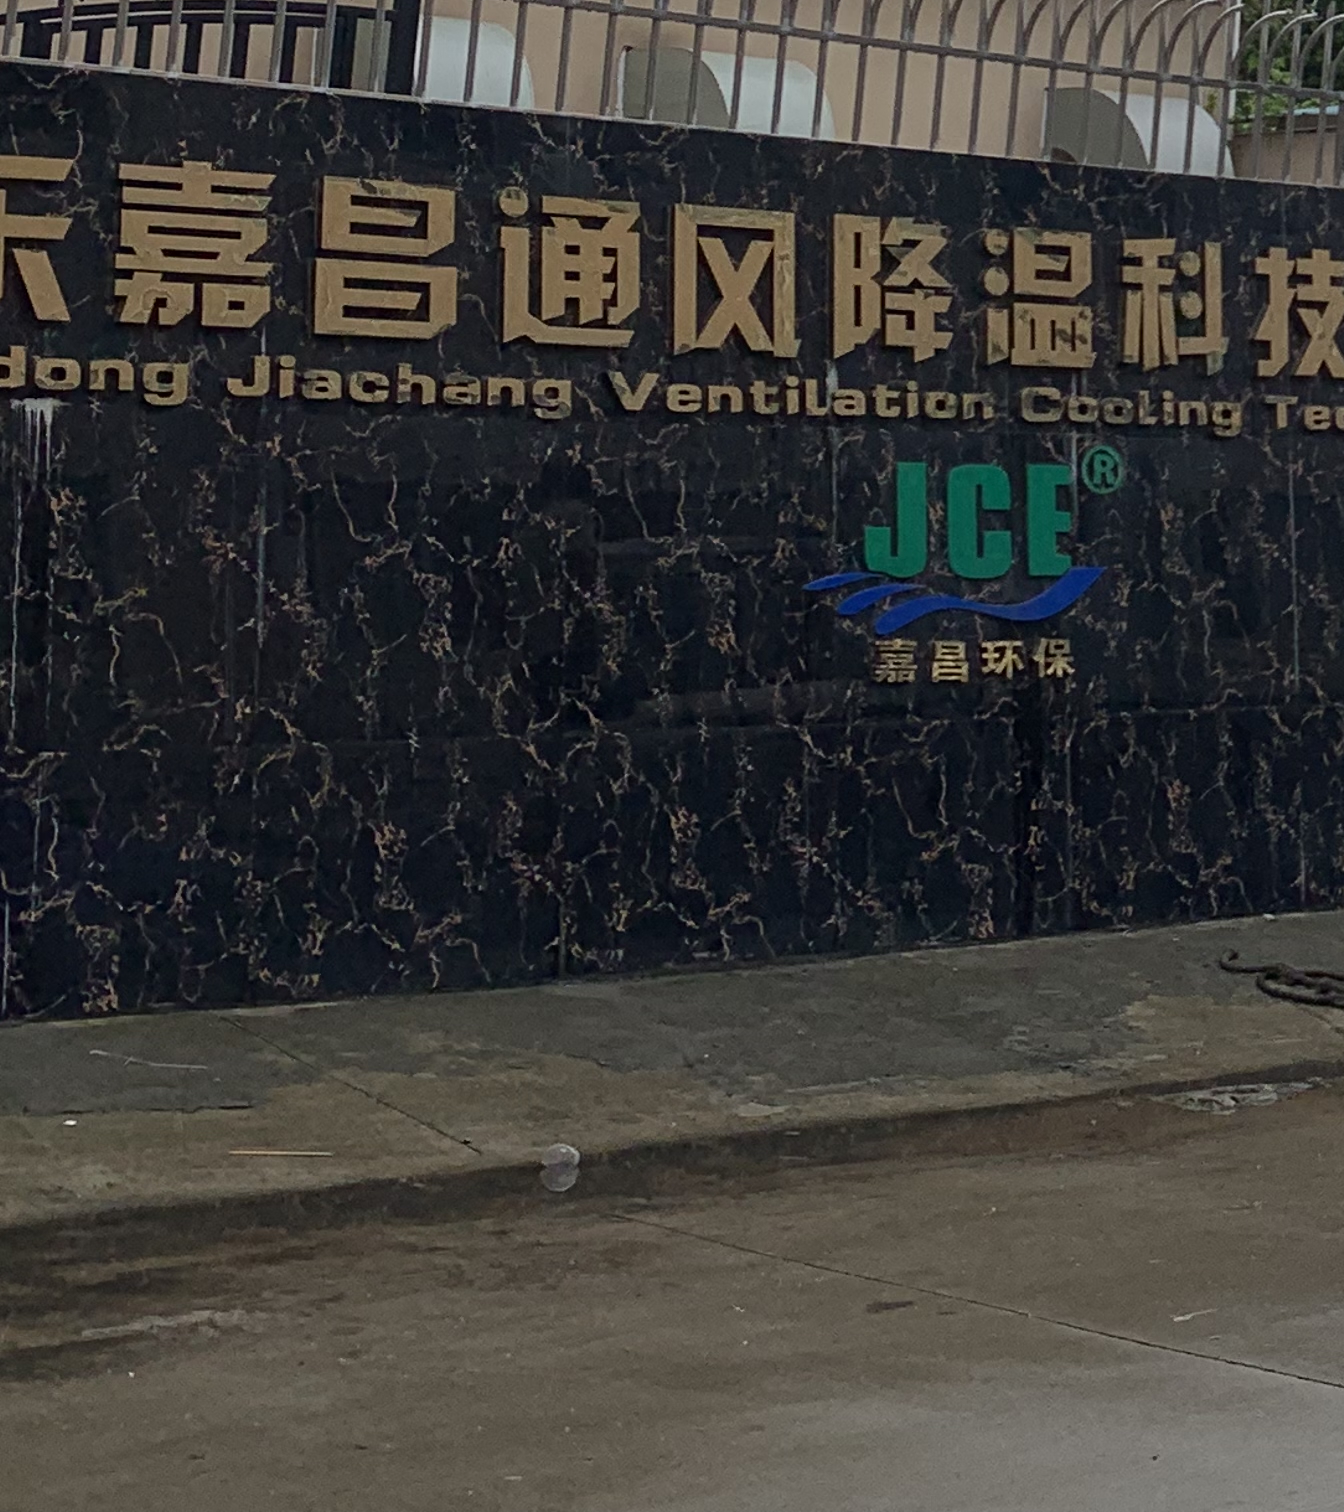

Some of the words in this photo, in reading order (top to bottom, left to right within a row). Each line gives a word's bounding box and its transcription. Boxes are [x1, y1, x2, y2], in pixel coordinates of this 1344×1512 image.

[226, 355, 573, 420] Jiachang
[610, 370, 995, 420] Ventilation
[1020, 385, 1242, 437] Cooling
[864, 461, 1073, 579] JCE
[873, 637, 1076, 684] 嘉昌环保
